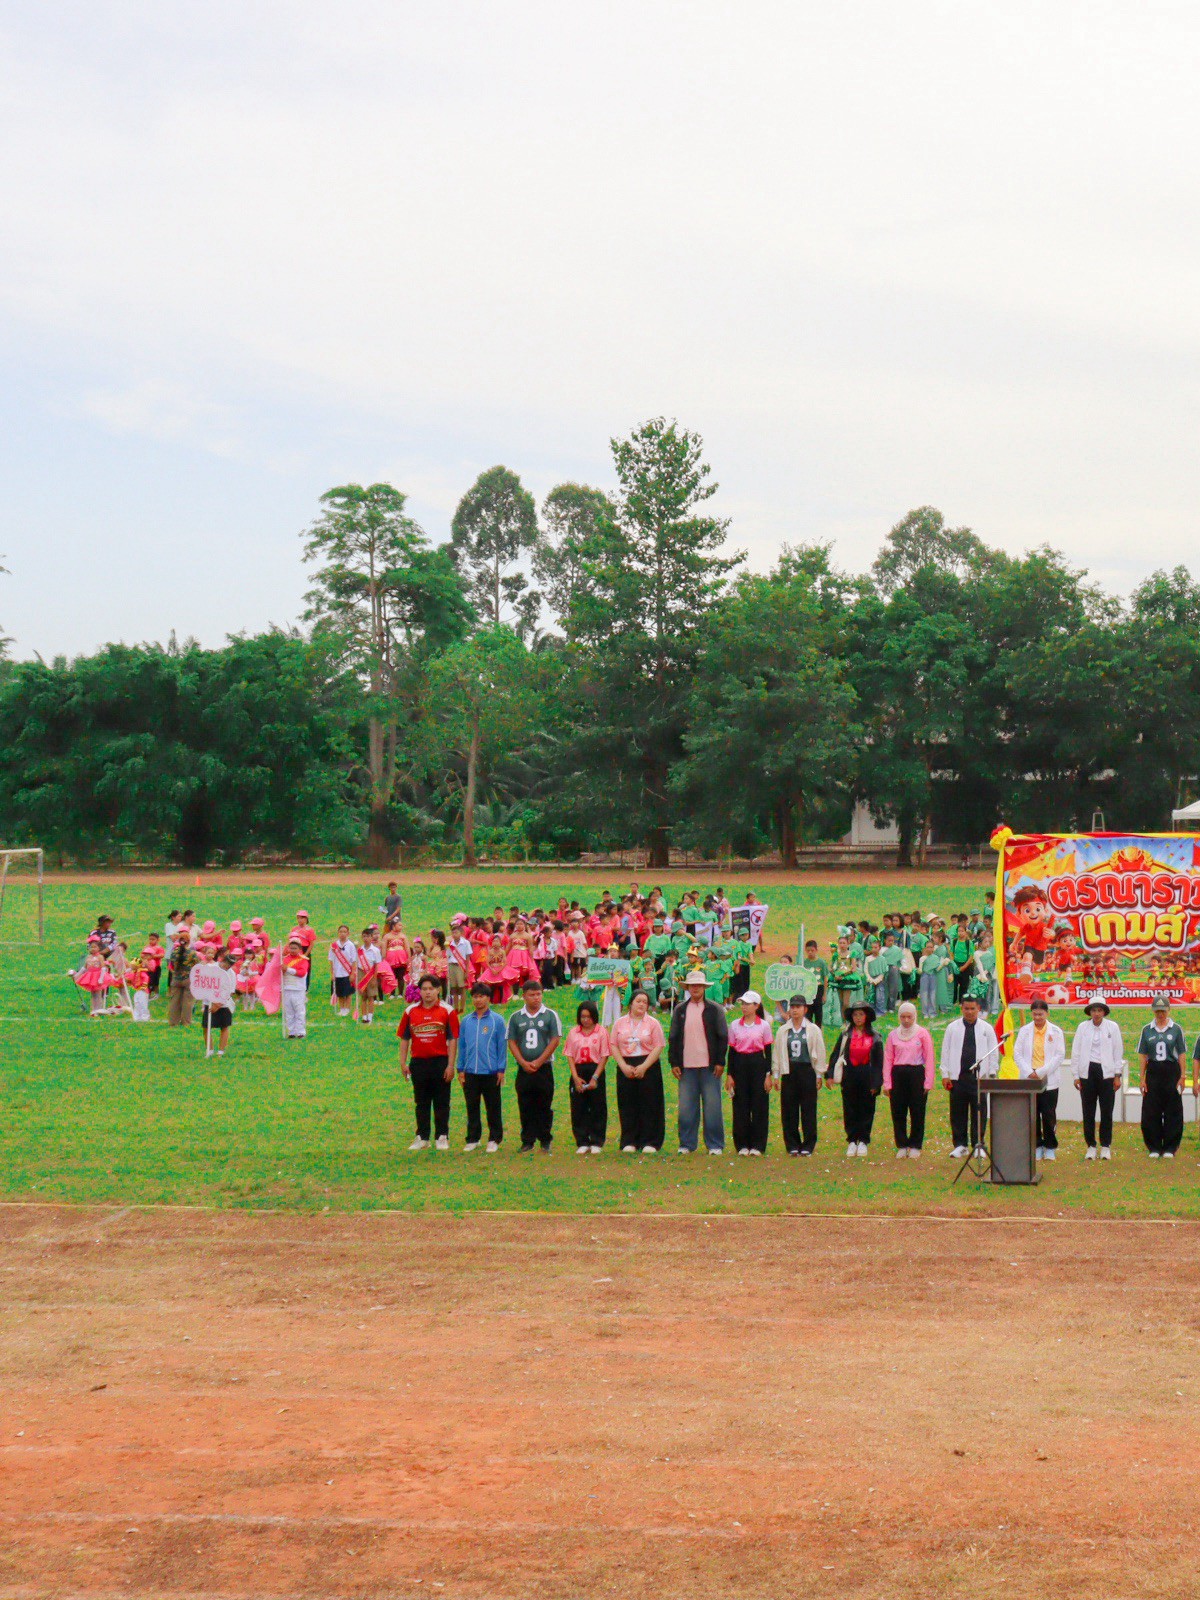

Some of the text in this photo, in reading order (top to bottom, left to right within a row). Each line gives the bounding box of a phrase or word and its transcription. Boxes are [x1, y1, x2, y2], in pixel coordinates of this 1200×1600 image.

[1083, 904, 1186, 944] เกมส์
[194, 969, 220, 998] สีชมพู
[769, 970, 805, 991] สีเขียว
[525, 1029, 538, 1049] 9
[790, 1040, 802, 1057] 9
[1155, 1041, 1167, 1061] 9
